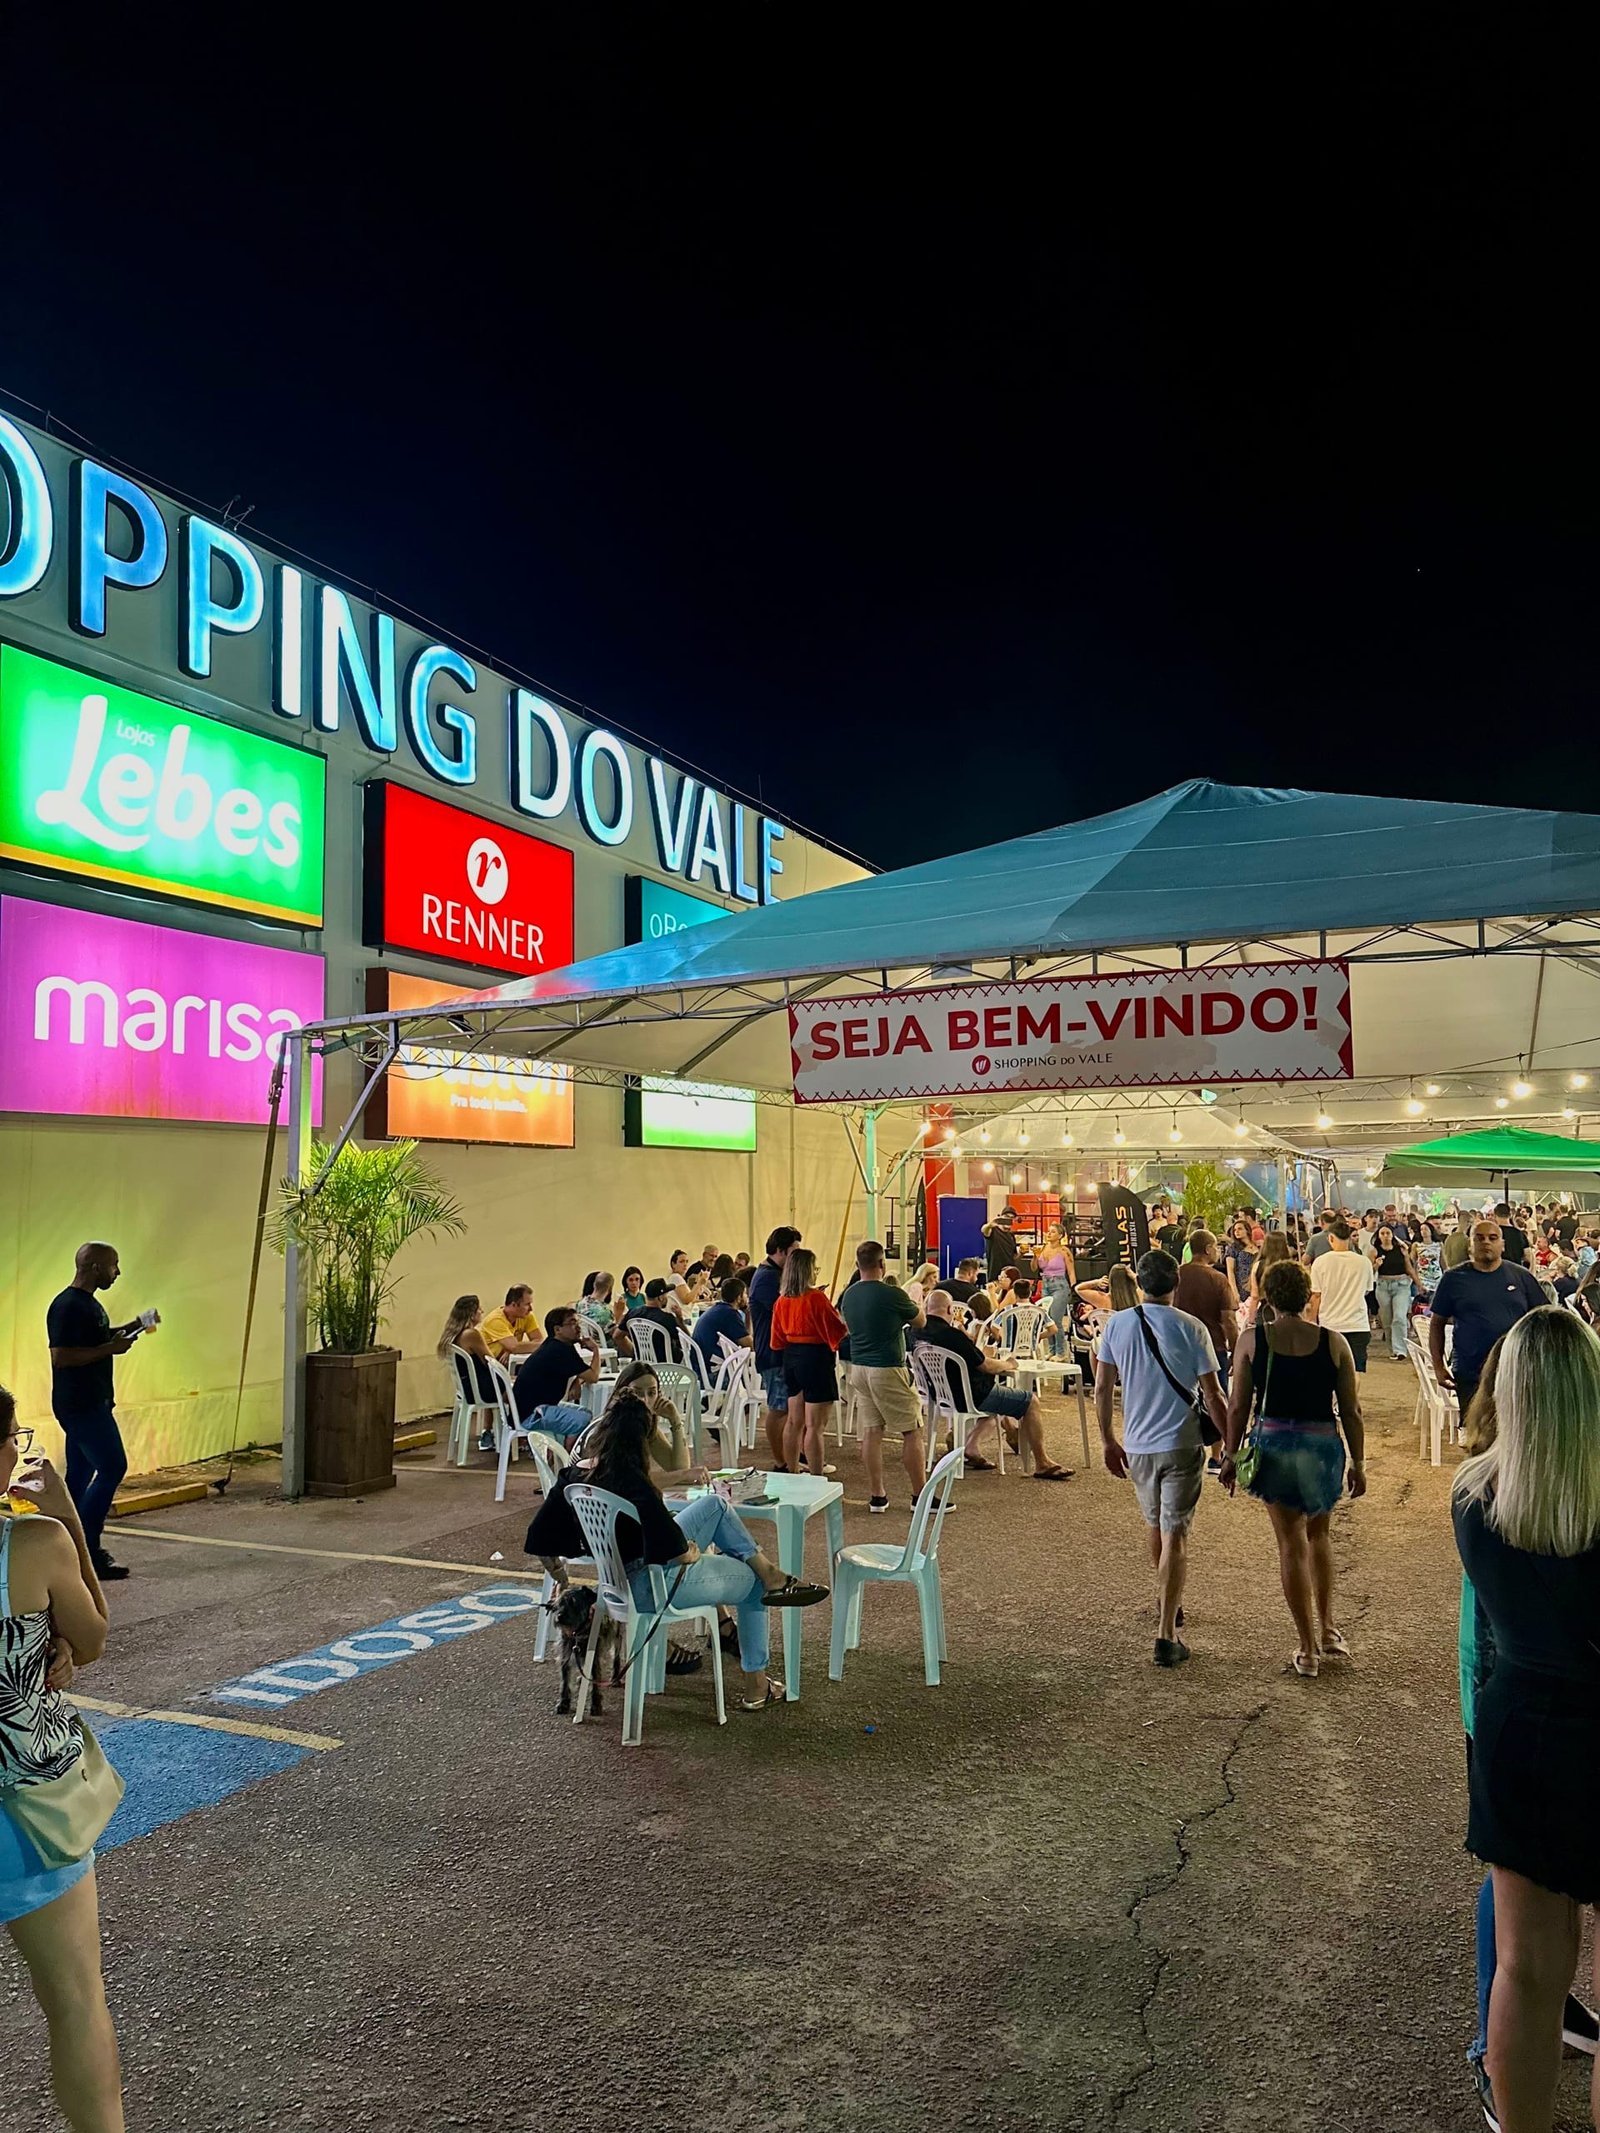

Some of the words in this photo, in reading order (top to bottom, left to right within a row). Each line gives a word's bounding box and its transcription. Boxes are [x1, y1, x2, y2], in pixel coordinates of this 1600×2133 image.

[116, 718, 156, 747] Lojas
[35, 694, 301, 868] Lebes
[512, 687, 633, 846] DO
[648, 757, 785, 906] VALE
[422, 893, 544, 964] RENNER
[34, 976, 303, 1066] marisa
[811, 1014, 934, 1061] SEJA
[947, 985, 1319, 1051] BEM-VINDO!
[994, 1055, 1057, 1070] SHOPPING
[1078, 1052, 1113, 1065] VALE
[220, 1588, 546, 1703] IDOSO
